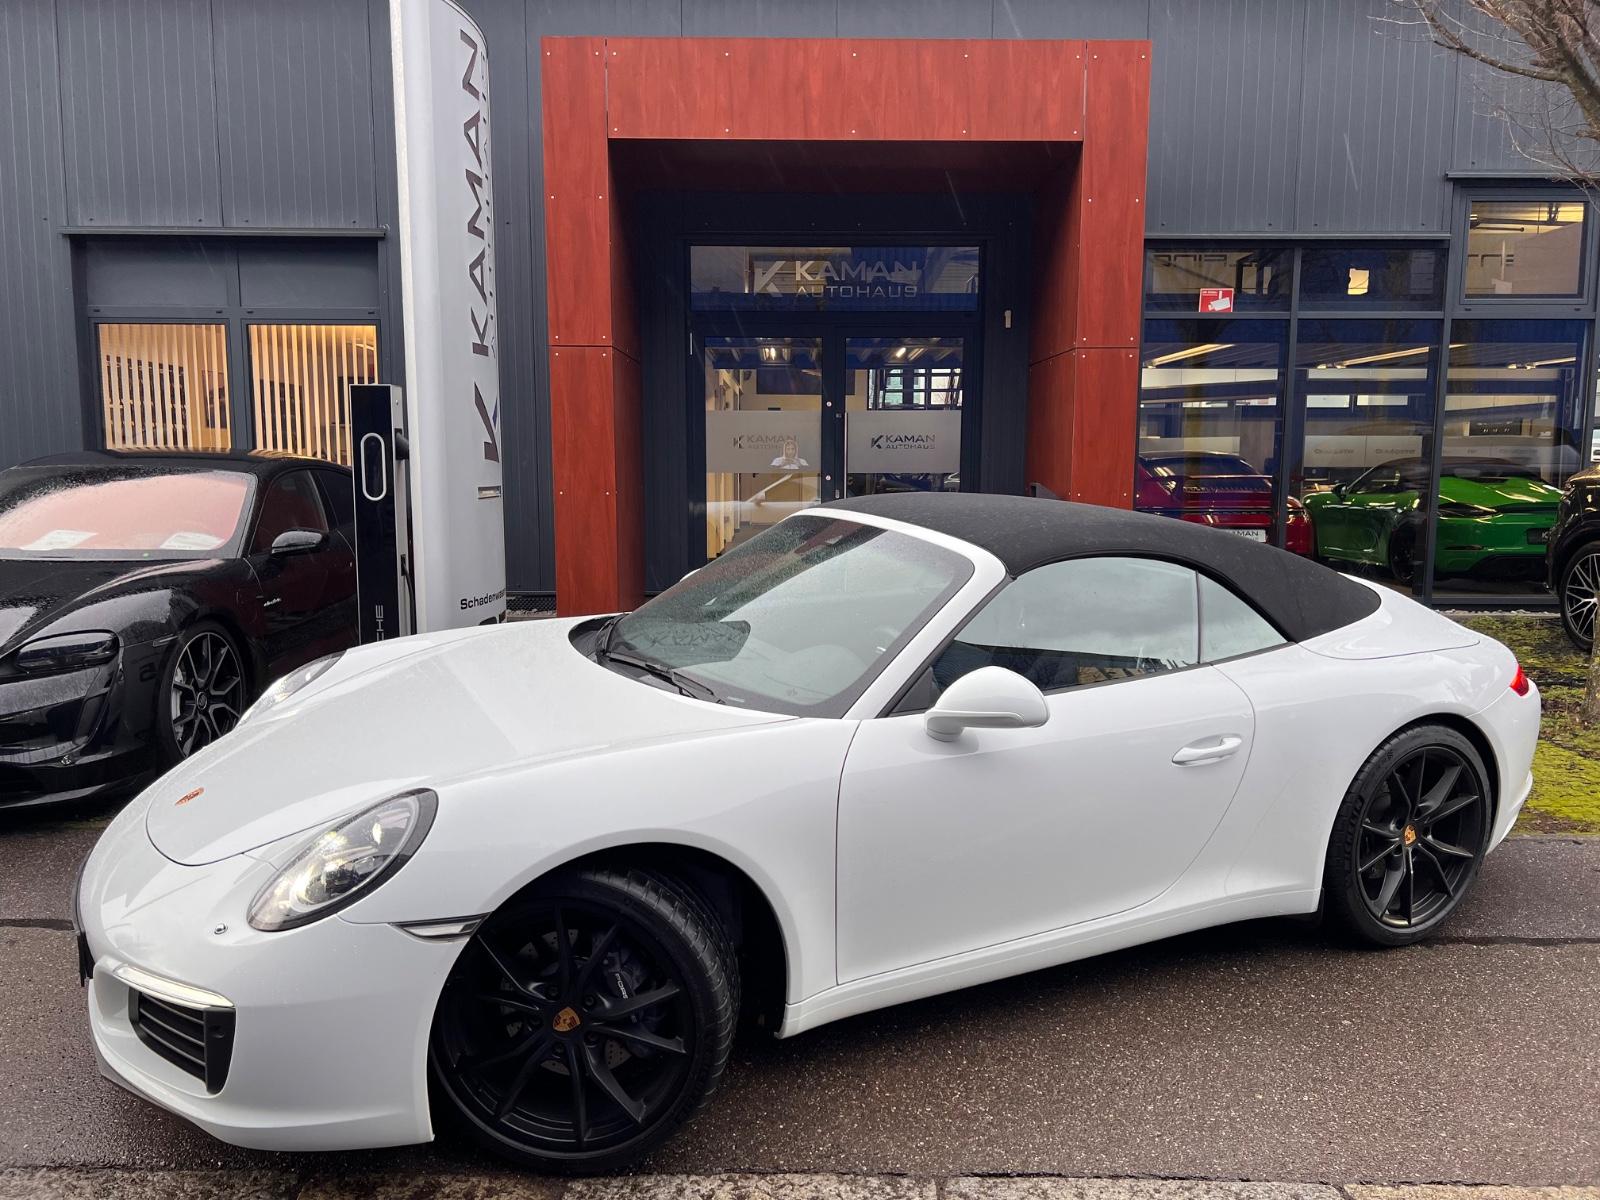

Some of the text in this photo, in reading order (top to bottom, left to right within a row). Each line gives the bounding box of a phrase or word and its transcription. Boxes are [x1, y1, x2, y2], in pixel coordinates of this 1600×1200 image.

[460, 29, 489, 357] KAMAN
[795, 260, 918, 282] KAMAN
[795, 285, 918, 298] AUTOHAUS
[885, 434, 936, 443] KAMAN
